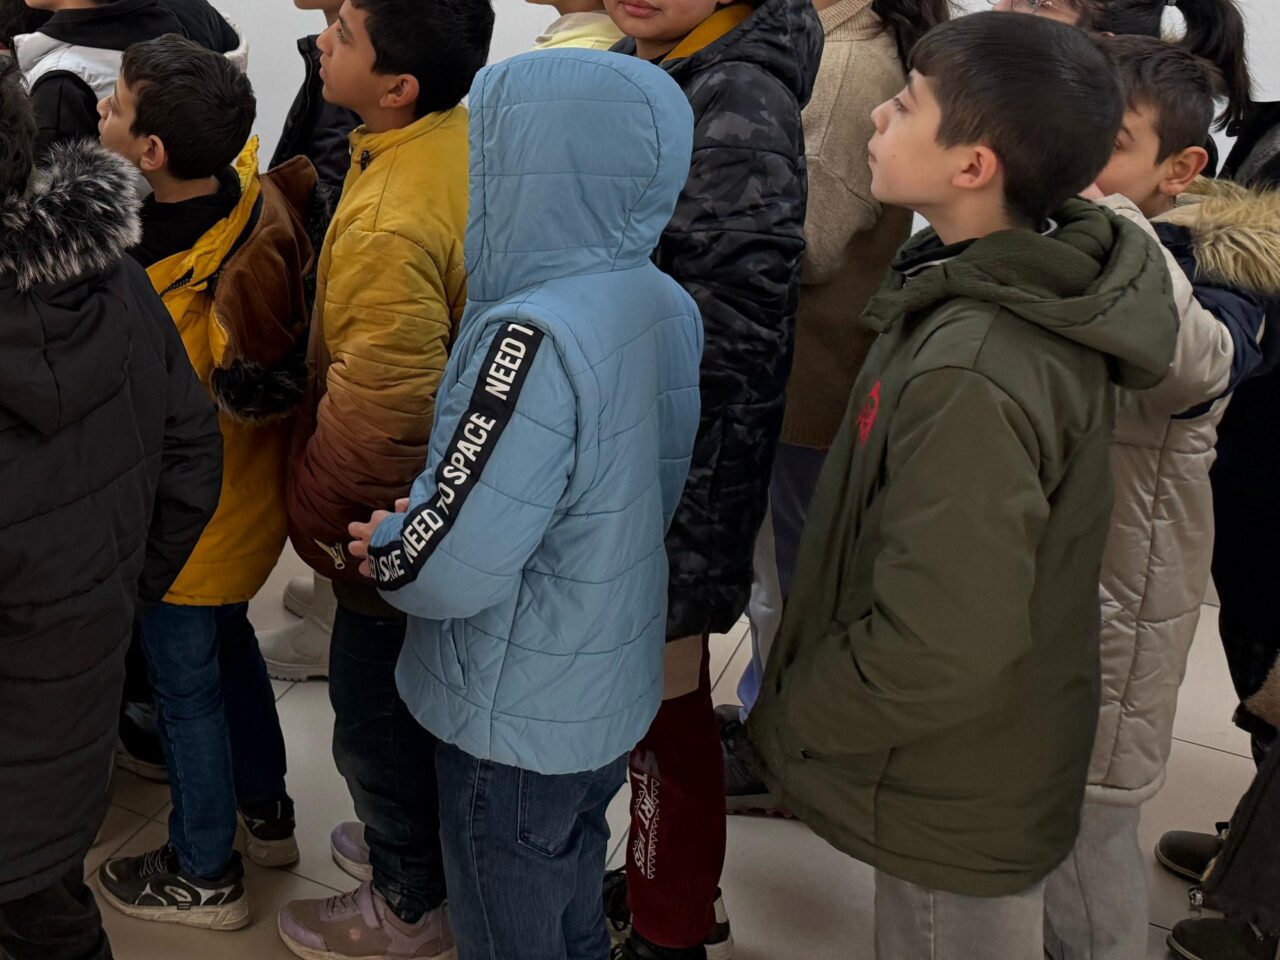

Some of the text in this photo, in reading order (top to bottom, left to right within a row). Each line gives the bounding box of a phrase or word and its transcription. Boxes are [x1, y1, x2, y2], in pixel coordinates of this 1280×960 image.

[402, 508, 444, 564] NEED
[443, 412, 497, 486] SPACE
[485, 341, 527, 401] NEED
